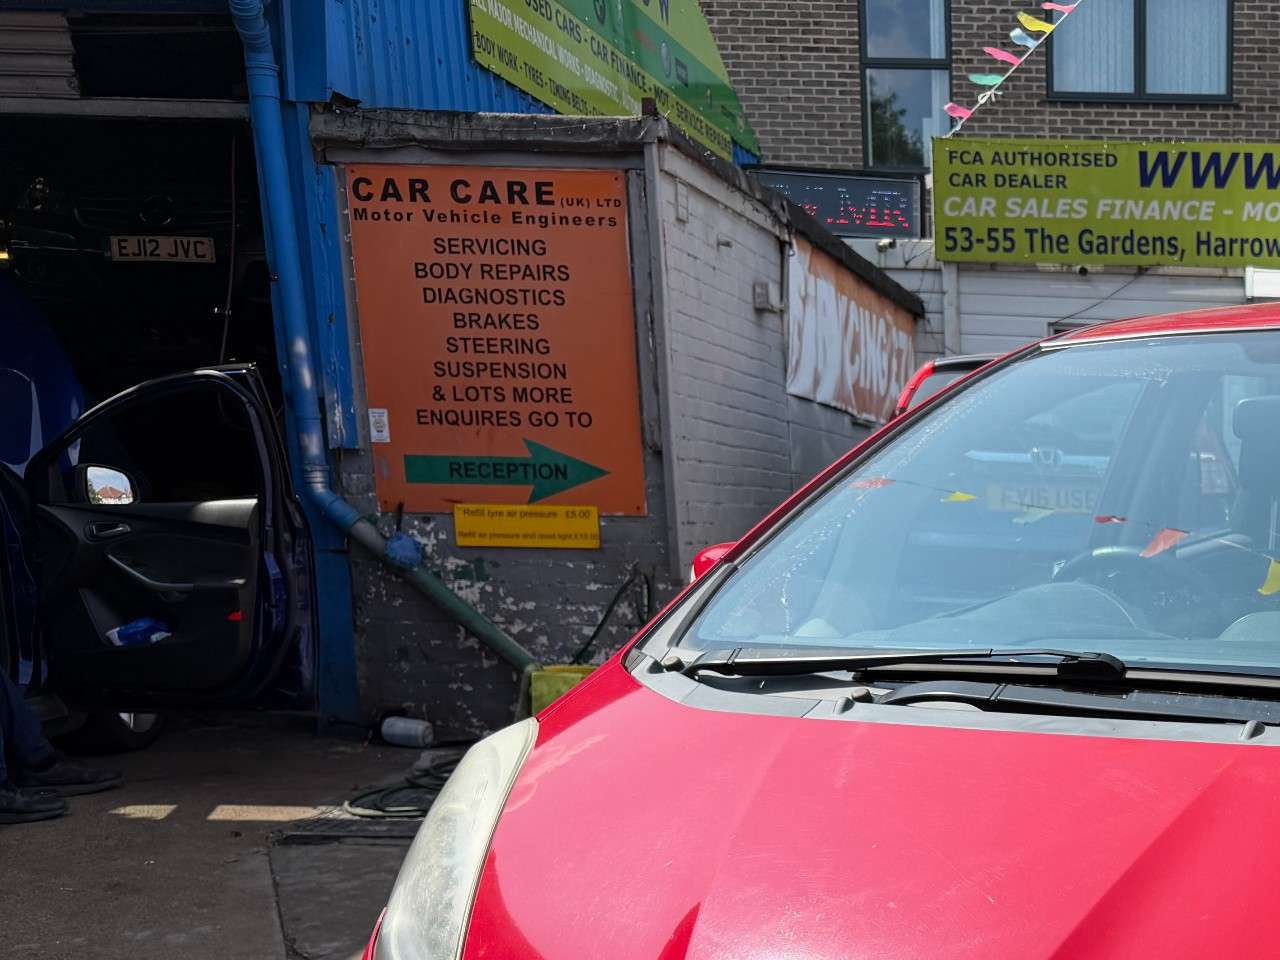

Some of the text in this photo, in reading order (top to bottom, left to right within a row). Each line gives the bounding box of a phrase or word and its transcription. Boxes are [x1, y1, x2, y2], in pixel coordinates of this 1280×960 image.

[525, 0, 552, 21] SED
[555, 9, 582, 44] CARS
[591, 36, 609, 64] CAR
[611, 50, 647, 93] FINANCE
[476, 32, 495, 58] BODY
[498, 44, 518, 72] WORK
[523, 62, 543, 88] TYRES
[949, 151, 1118, 168] FCA AUTHORISED
[949, 172, 1067, 189] CAR DEALER
[352, 177, 622, 209] CAR CARE (UK) LTD
[353, 208, 618, 229] Motor Vehicle Engineers
[943, 196, 997, 217] CAR
[1005, 198, 1088, 219] SALES
[1095, 200, 1216, 222] FINANCE
[118, 239, 207, 258] EJ12 JVC
[433, 237, 547, 257] SERVICING
[943, 227, 1016, 254] 53-55
[1024, 228, 1075, 254] The
[1080, 229, 1186, 261] Gardens,
[414, 262, 570, 282] BODY REPAIRS
[422, 287, 566, 306] DIAGNOSTICS
[453, 312, 540, 331] BRAKES
[446, 337, 551, 355] STEERING
[433, 361, 567, 380] SUSPENSION
[432, 385, 573, 404] & LOTS MORE
[416, 409, 593, 428] ENQUIRES GO TO
[449, 461, 568, 481] RECEPTION
[487, 510, 503, 519] tyre
[506, 509, 517, 517] air
[520, 510, 558, 519] pressure
